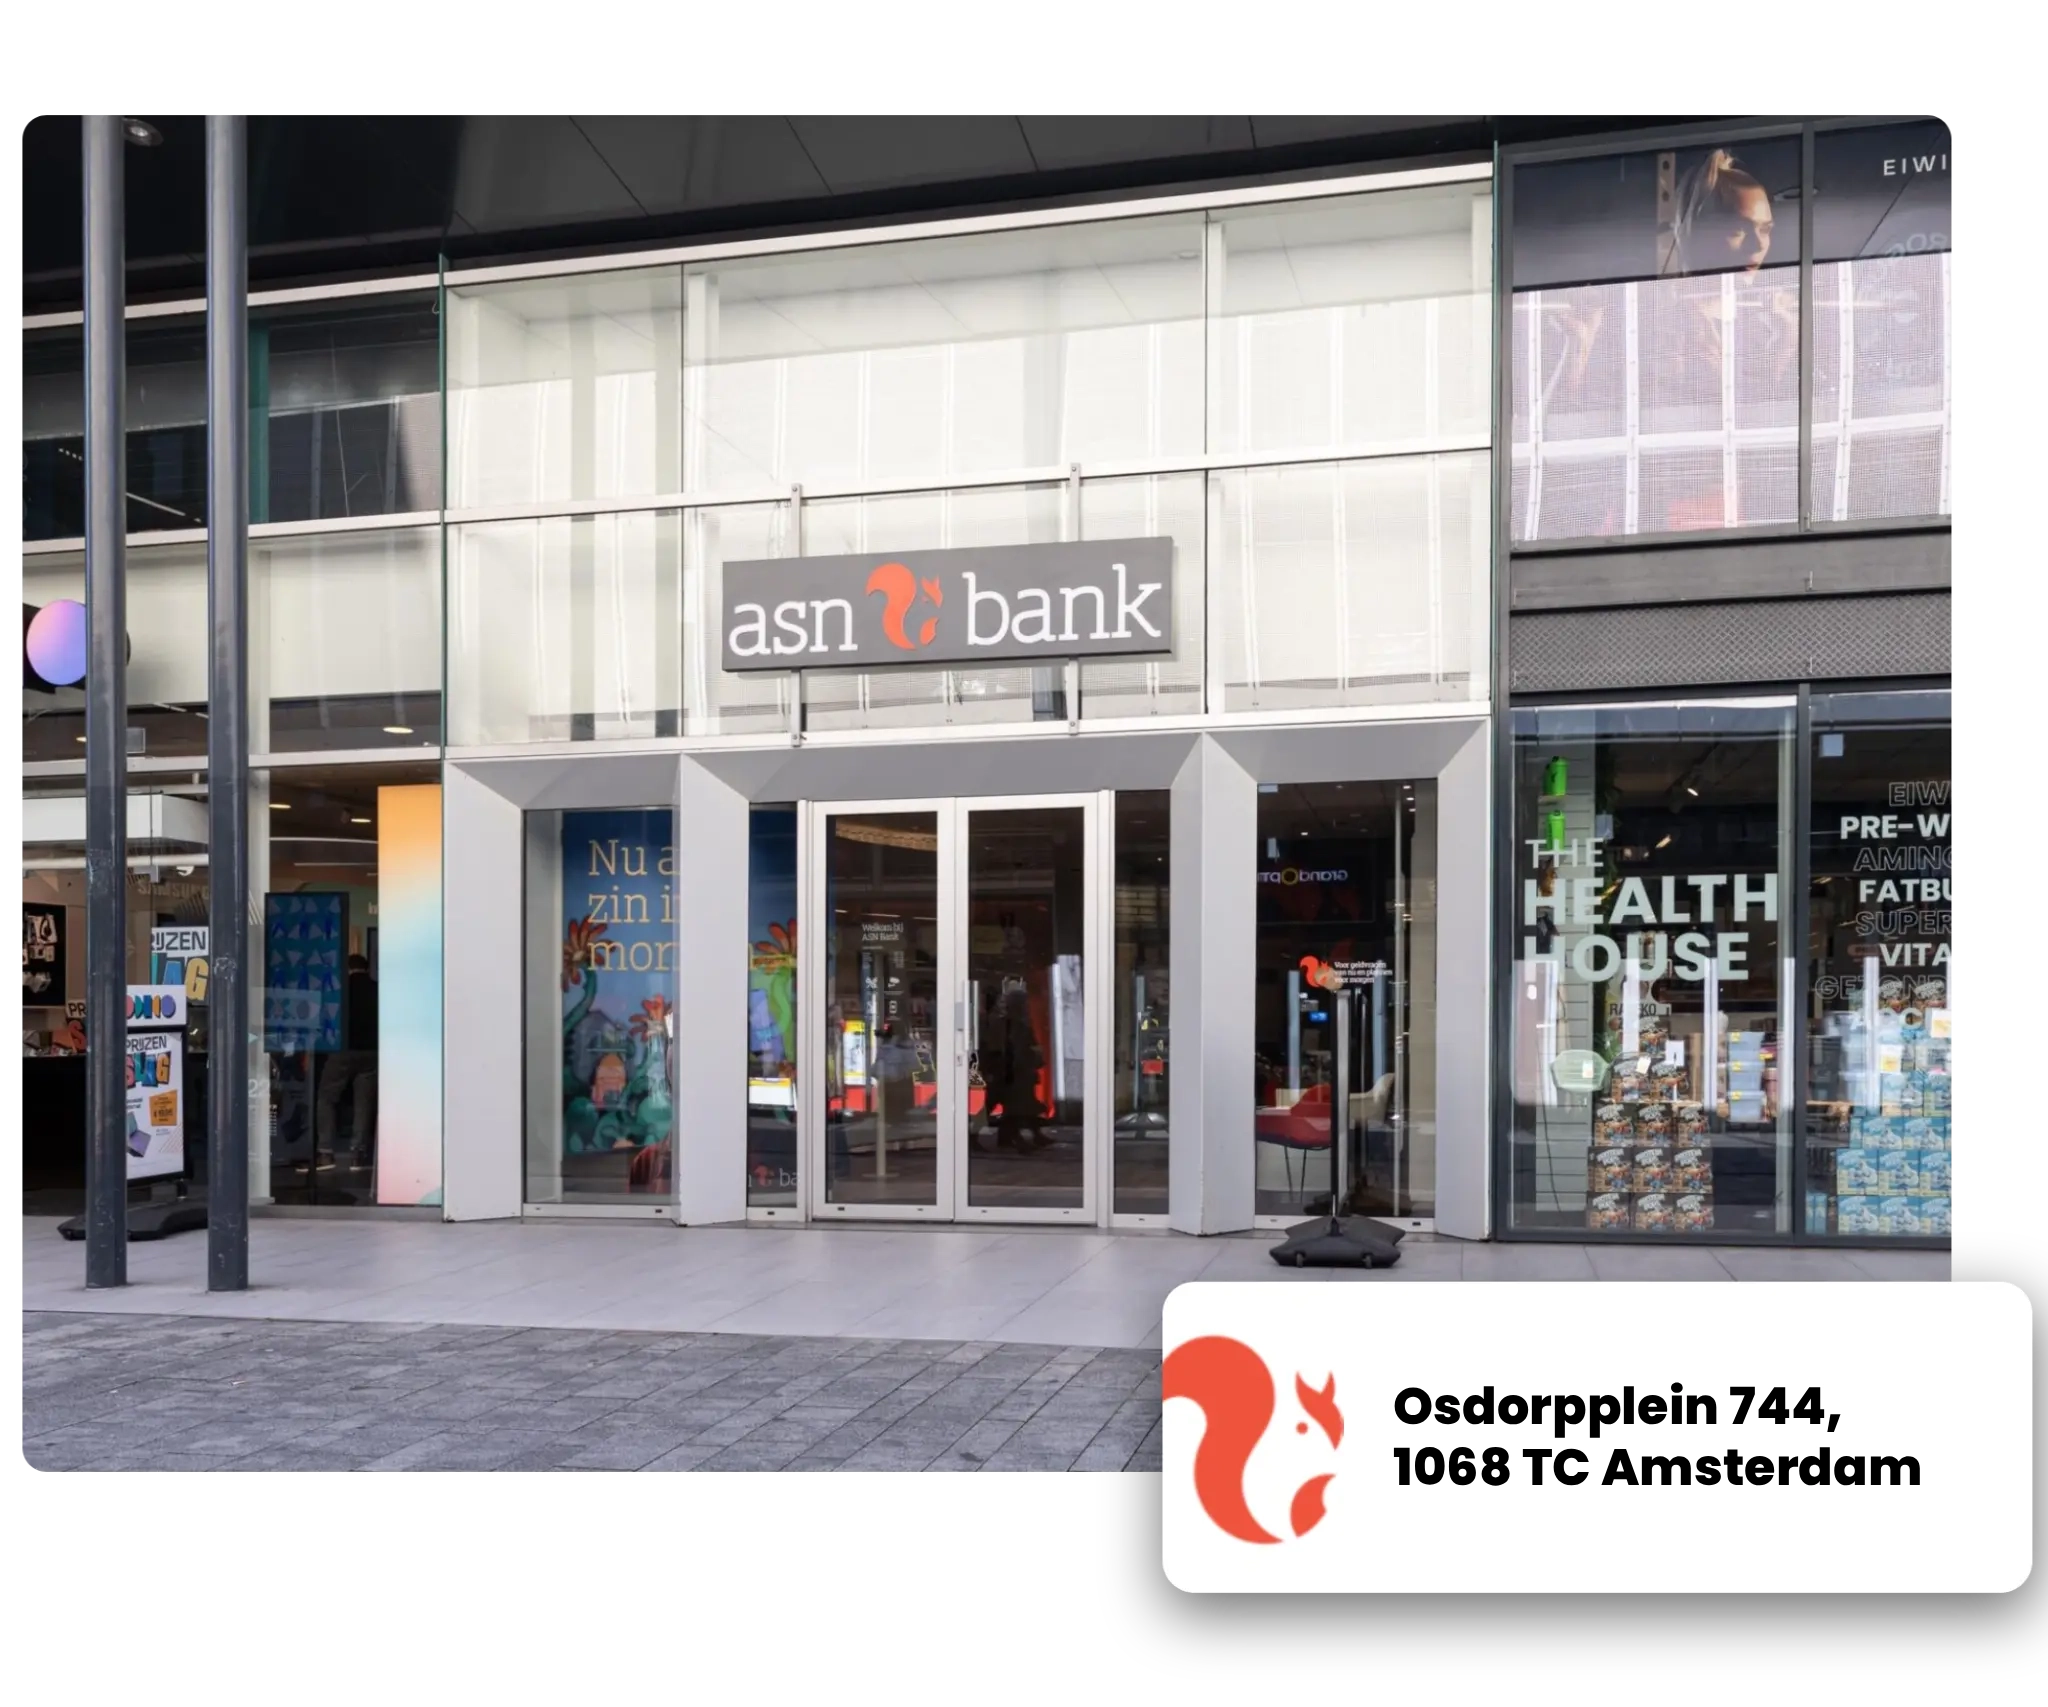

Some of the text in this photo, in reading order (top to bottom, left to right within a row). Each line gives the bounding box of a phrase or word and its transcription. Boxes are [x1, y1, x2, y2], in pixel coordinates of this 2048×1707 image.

[1883, 154, 1948, 176] EIWI
[728, 563, 1162, 656] asn bank
[1840, 813, 1951, 840] PRE-W
[588, 839, 648, 876] Nu
[1525, 838, 1603, 868] THE
[588, 885, 650, 924] zin
[1524, 873, 1778, 926] HEALTH
[1855, 910, 1952, 936] SUPER
[1524, 931, 1749, 984] HOUSE
[1879, 943, 1952, 967] VITA
